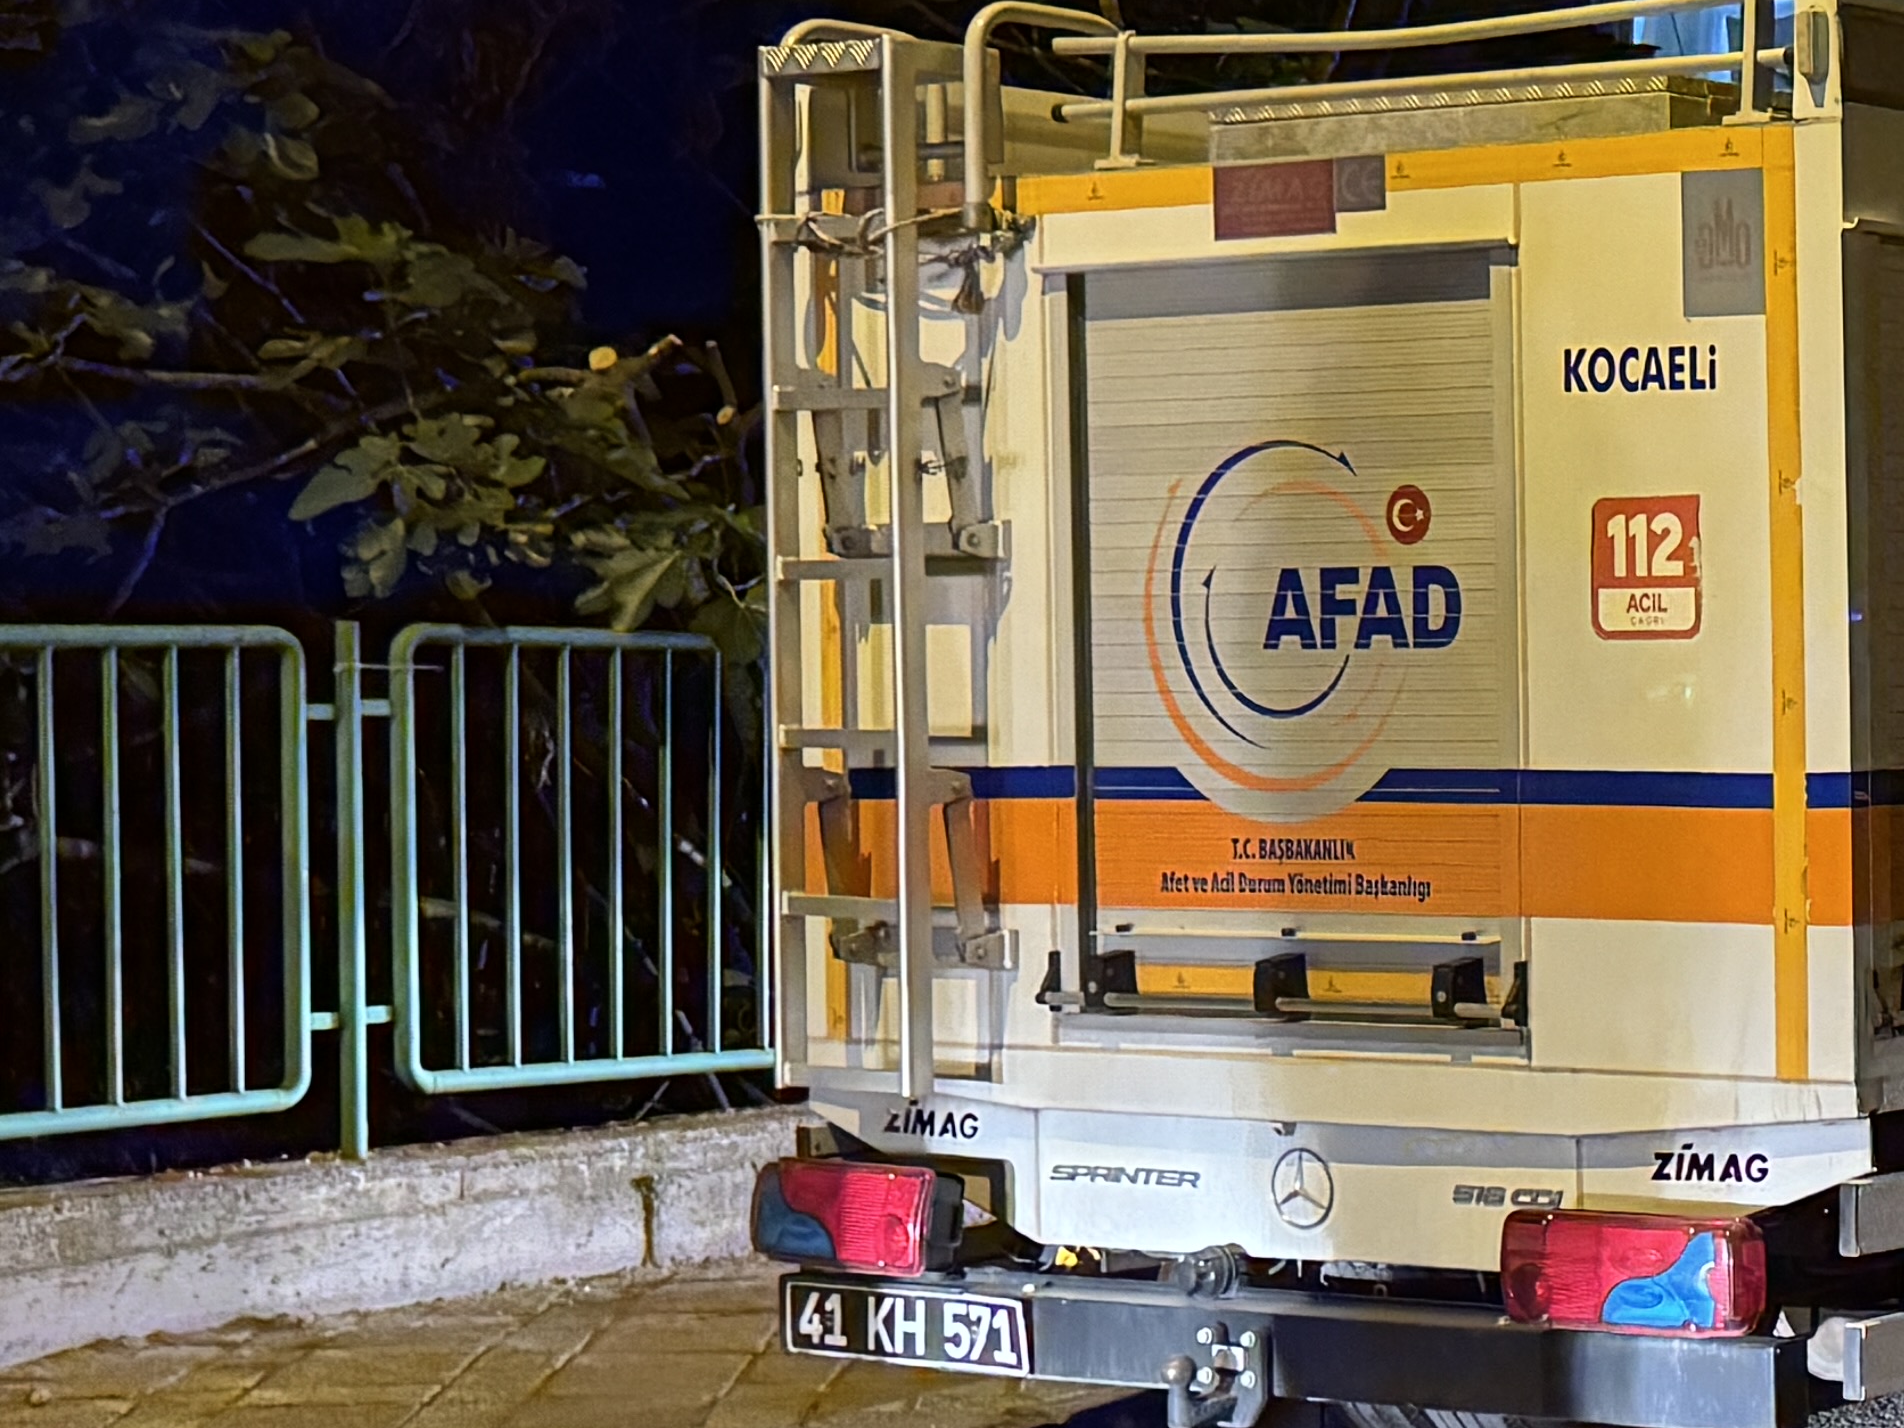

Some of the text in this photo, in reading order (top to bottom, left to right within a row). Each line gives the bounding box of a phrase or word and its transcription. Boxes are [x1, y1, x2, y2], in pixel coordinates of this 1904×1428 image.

[1606, 512, 1685, 578] 112
[1262, 564, 1463, 650] AFAD
[1231, 838, 1256, 860] T.C.
[1160, 871, 1189, 893] Afet
[1192, 876, 1209, 893] ve
[1049, 1164, 1201, 1189] SPRINTER
[799, 1291, 1018, 1366] 41 KH 571
